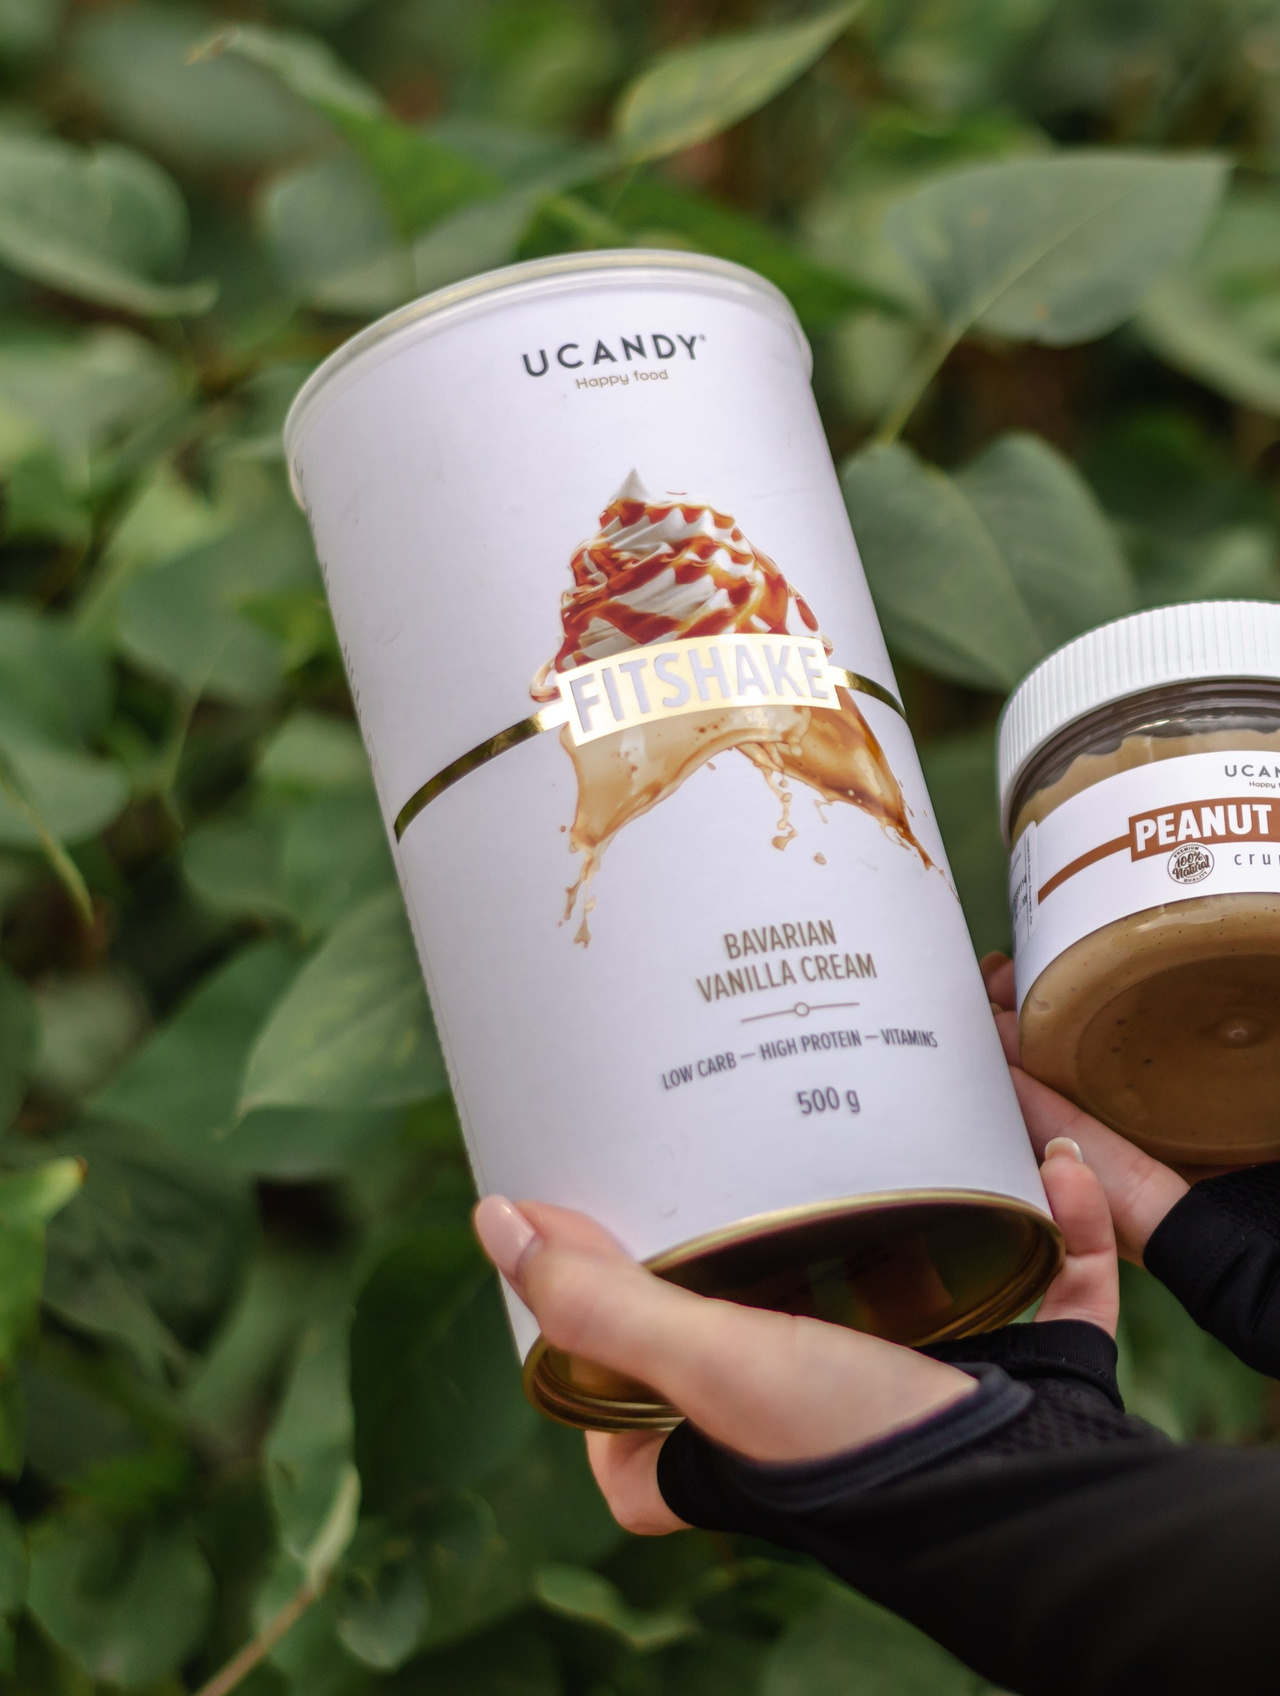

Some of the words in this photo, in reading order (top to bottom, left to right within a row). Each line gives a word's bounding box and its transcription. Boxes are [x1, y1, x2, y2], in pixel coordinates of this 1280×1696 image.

[576, 370, 630, 390] Happy
[633, 369, 669, 384] food
[569, 644, 829, 733] FITSHAKE
[1249, 781, 1276, 789] Happy
[1135, 804, 1271, 852] PEANUT
[1174, 846, 1199, 858] PREMIUM
[1176, 851, 1203, 868] 100%
[1172, 854, 1210, 879] Natural
[1184, 871, 1207, 882] QUALITY
[723, 919, 837, 960] BAVARIAN
[696, 959, 798, 1003] VANILLA
[799, 953, 878, 983] CREAM
[661, 1064, 694, 1090] LOW
[697, 1051, 738, 1078] CARB
[759, 1037, 799, 1061] HIGH
[800, 1029, 863, 1053] PROTEIN
[880, 1028, 939, 1048] VITAMINS
[796, 1087, 841, 1115] 500
[846, 1089, 861, 1114] g
